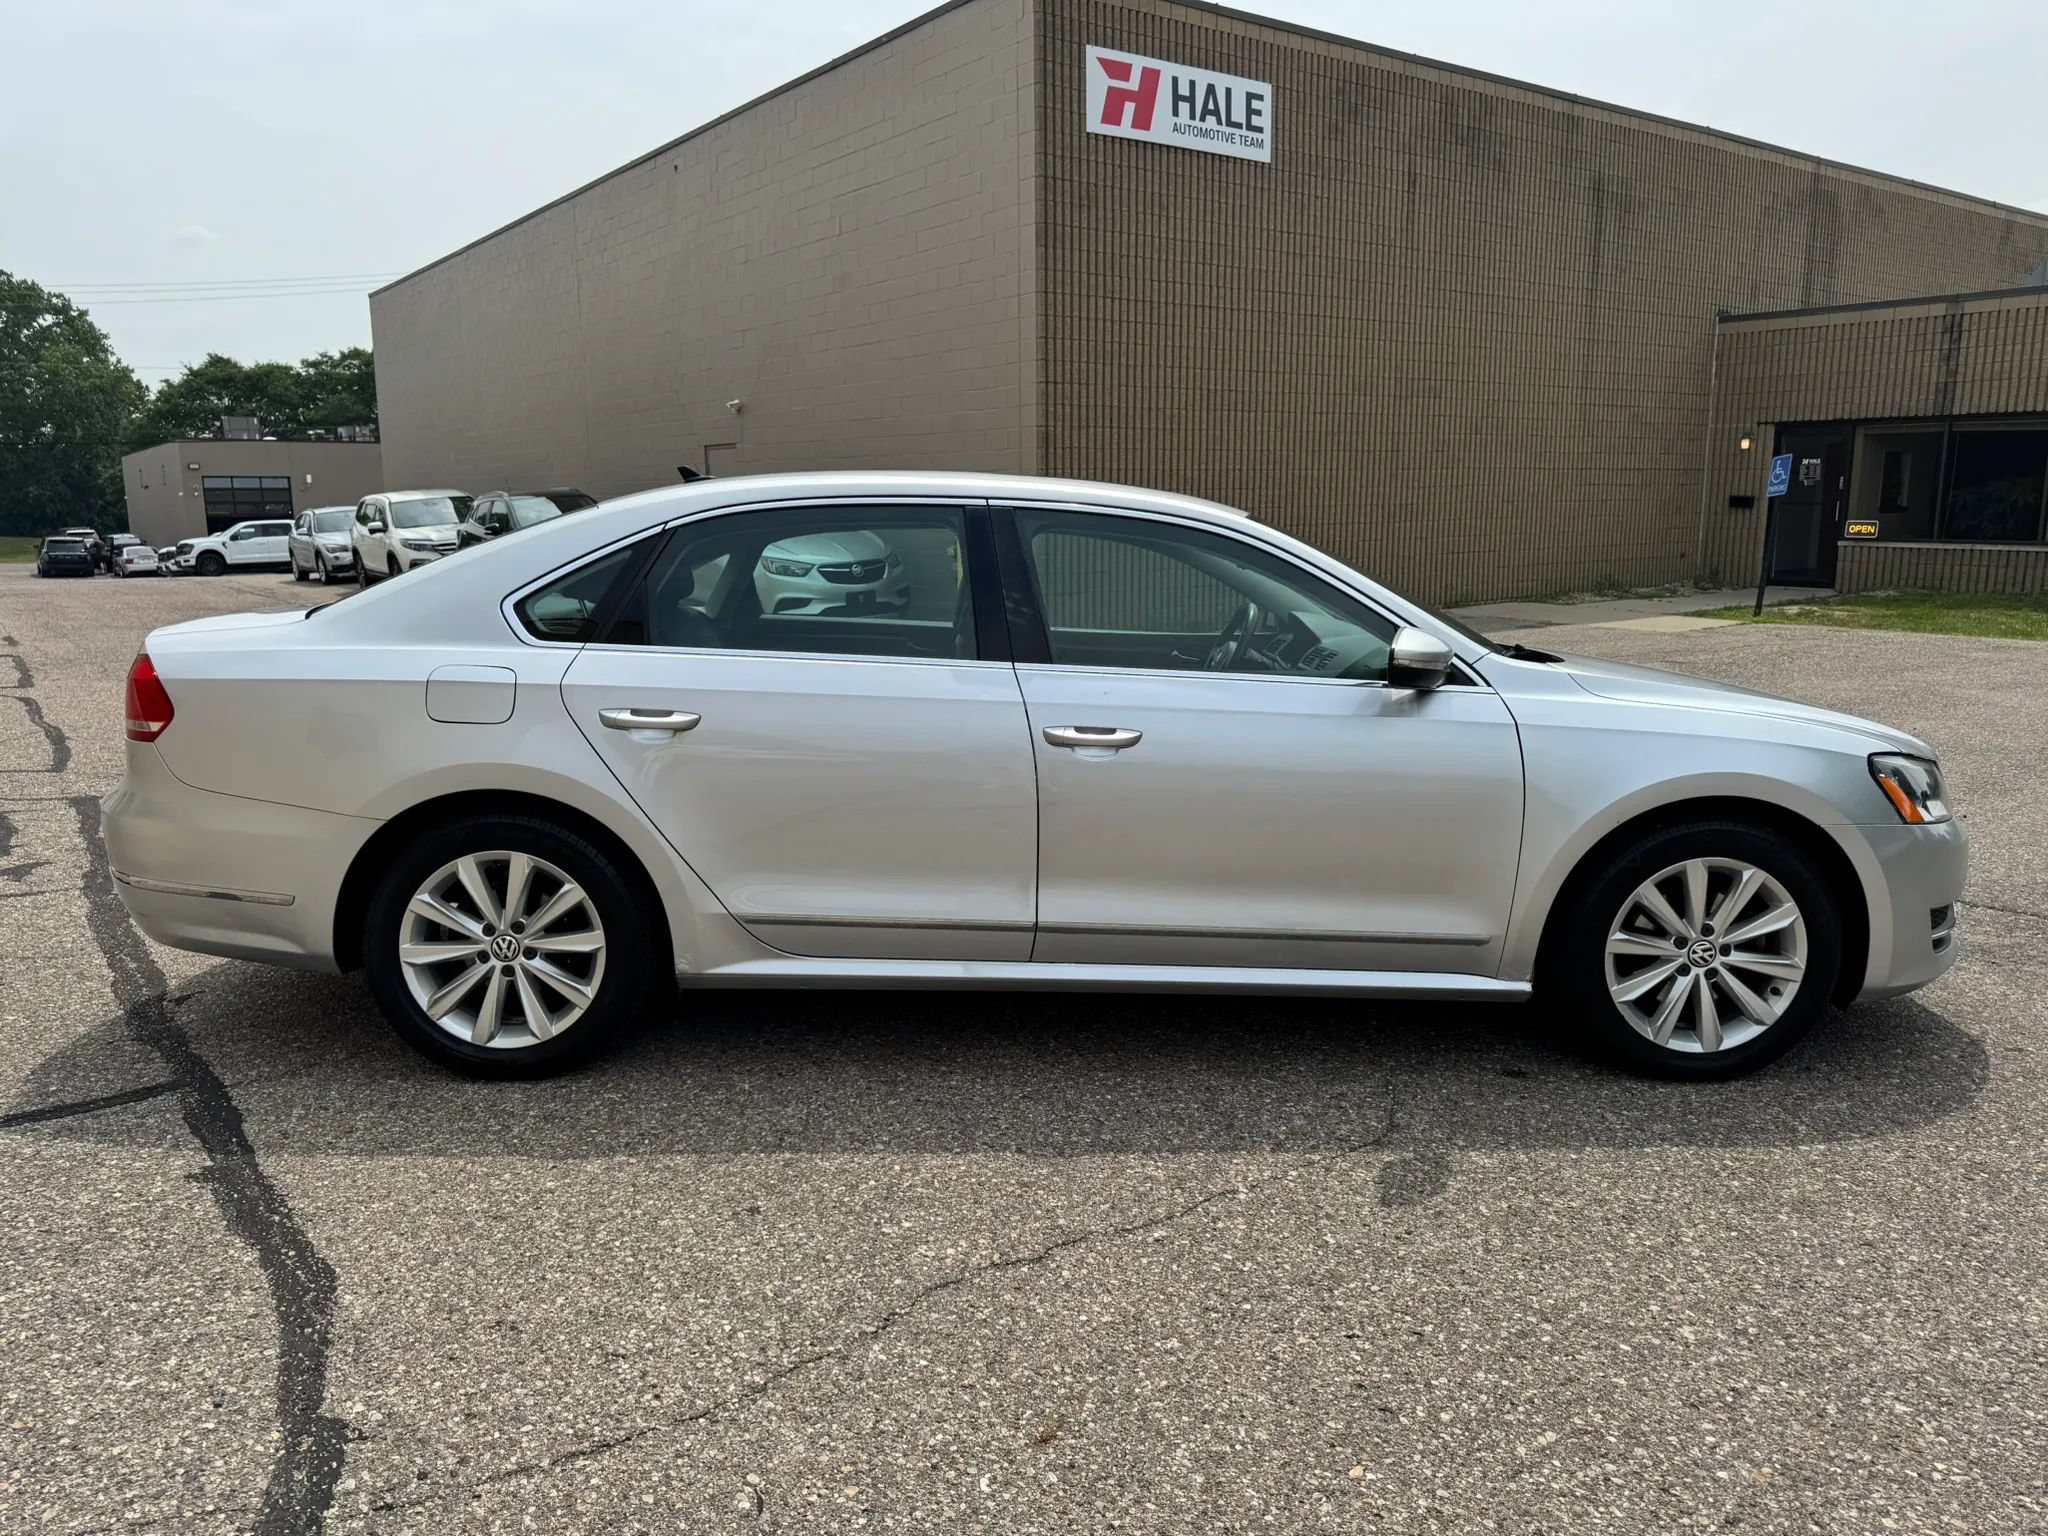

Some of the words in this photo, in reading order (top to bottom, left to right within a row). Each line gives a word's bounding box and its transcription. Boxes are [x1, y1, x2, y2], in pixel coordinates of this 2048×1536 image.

[1172, 75, 1264, 134] HALE
[1172, 121, 1236, 145] AUTOMOTIVE
[1238, 134, 1264, 150] TEAM
[1849, 524, 1875, 533] OPEN
